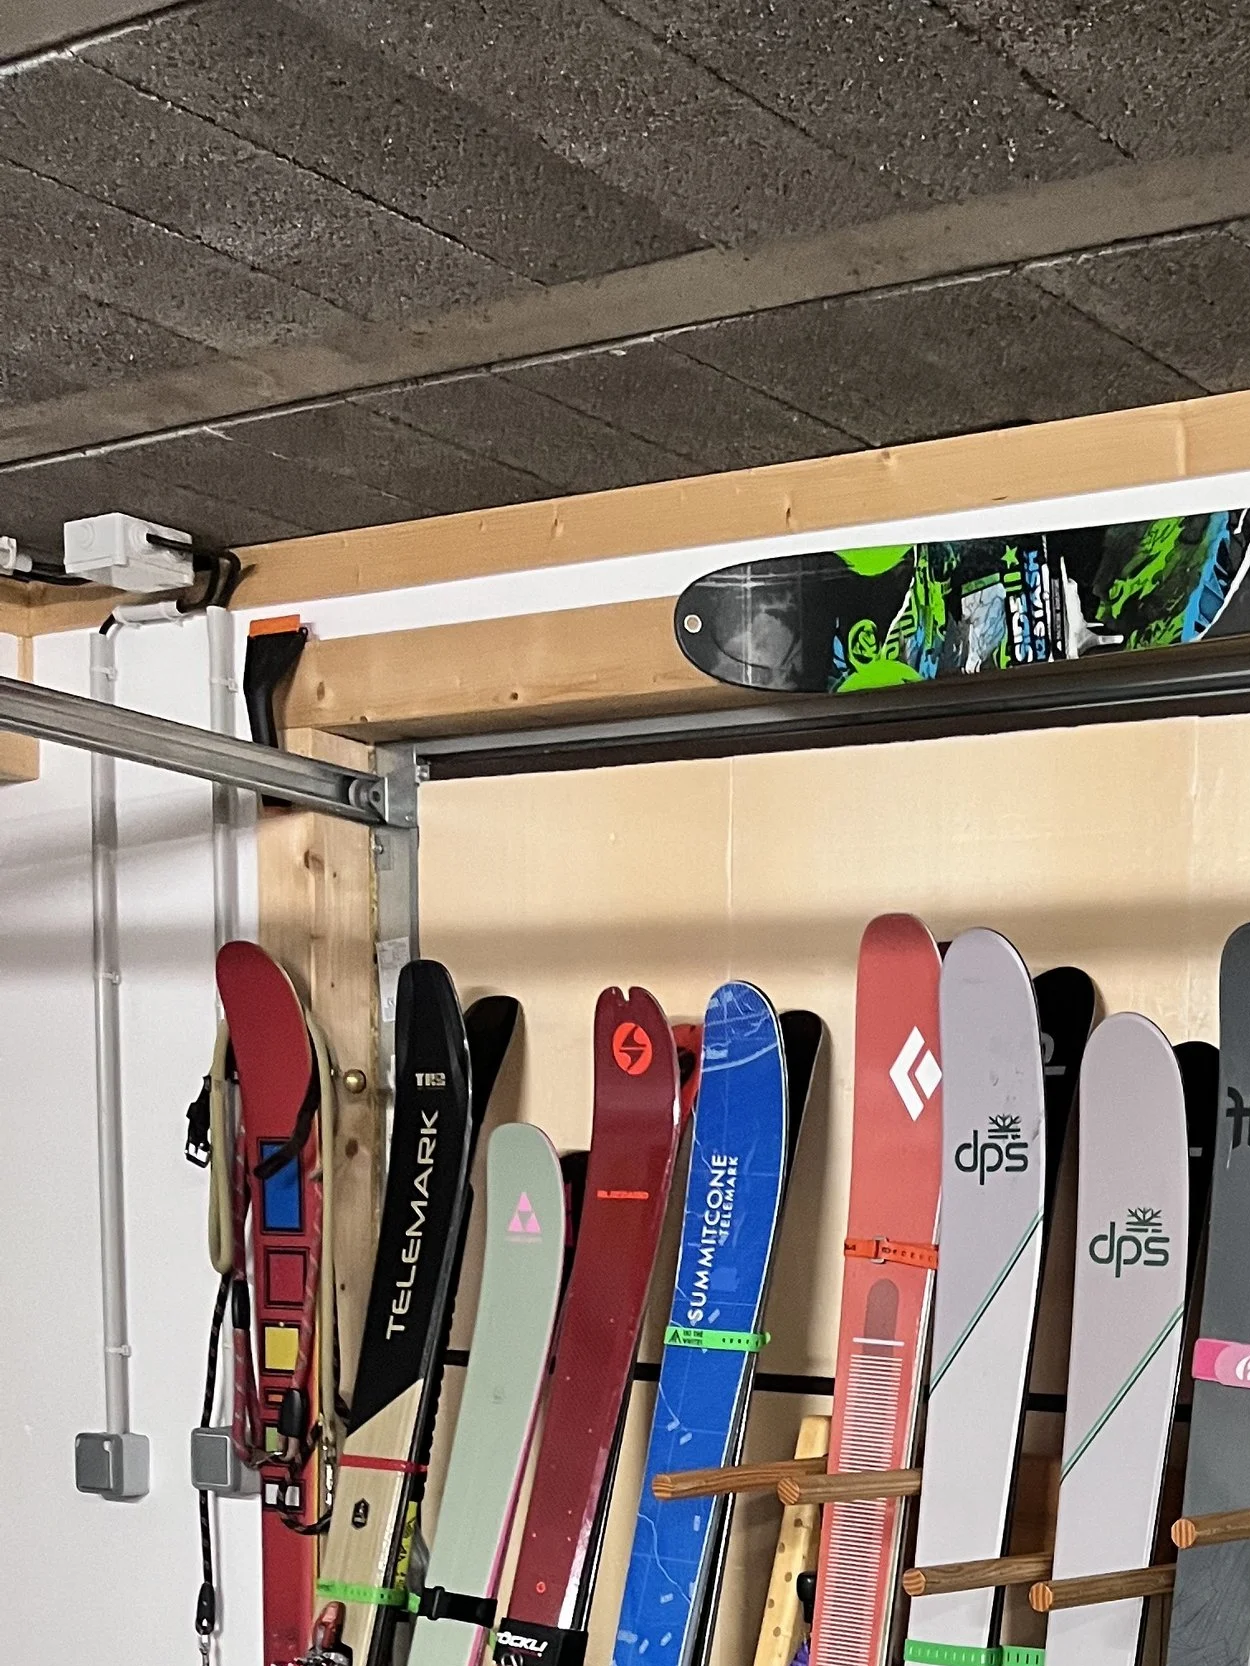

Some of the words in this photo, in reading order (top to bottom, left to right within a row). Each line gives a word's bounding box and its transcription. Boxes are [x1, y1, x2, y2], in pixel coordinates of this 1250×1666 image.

[719, 1156, 739, 1237] TELEMARK
[954, 1129, 1029, 1185] dps
[386, 1110, 439, 1340] TELEMARK
[687, 1154, 727, 1323] SUMMITCONE
[1088, 1221, 1171, 1278] dps
